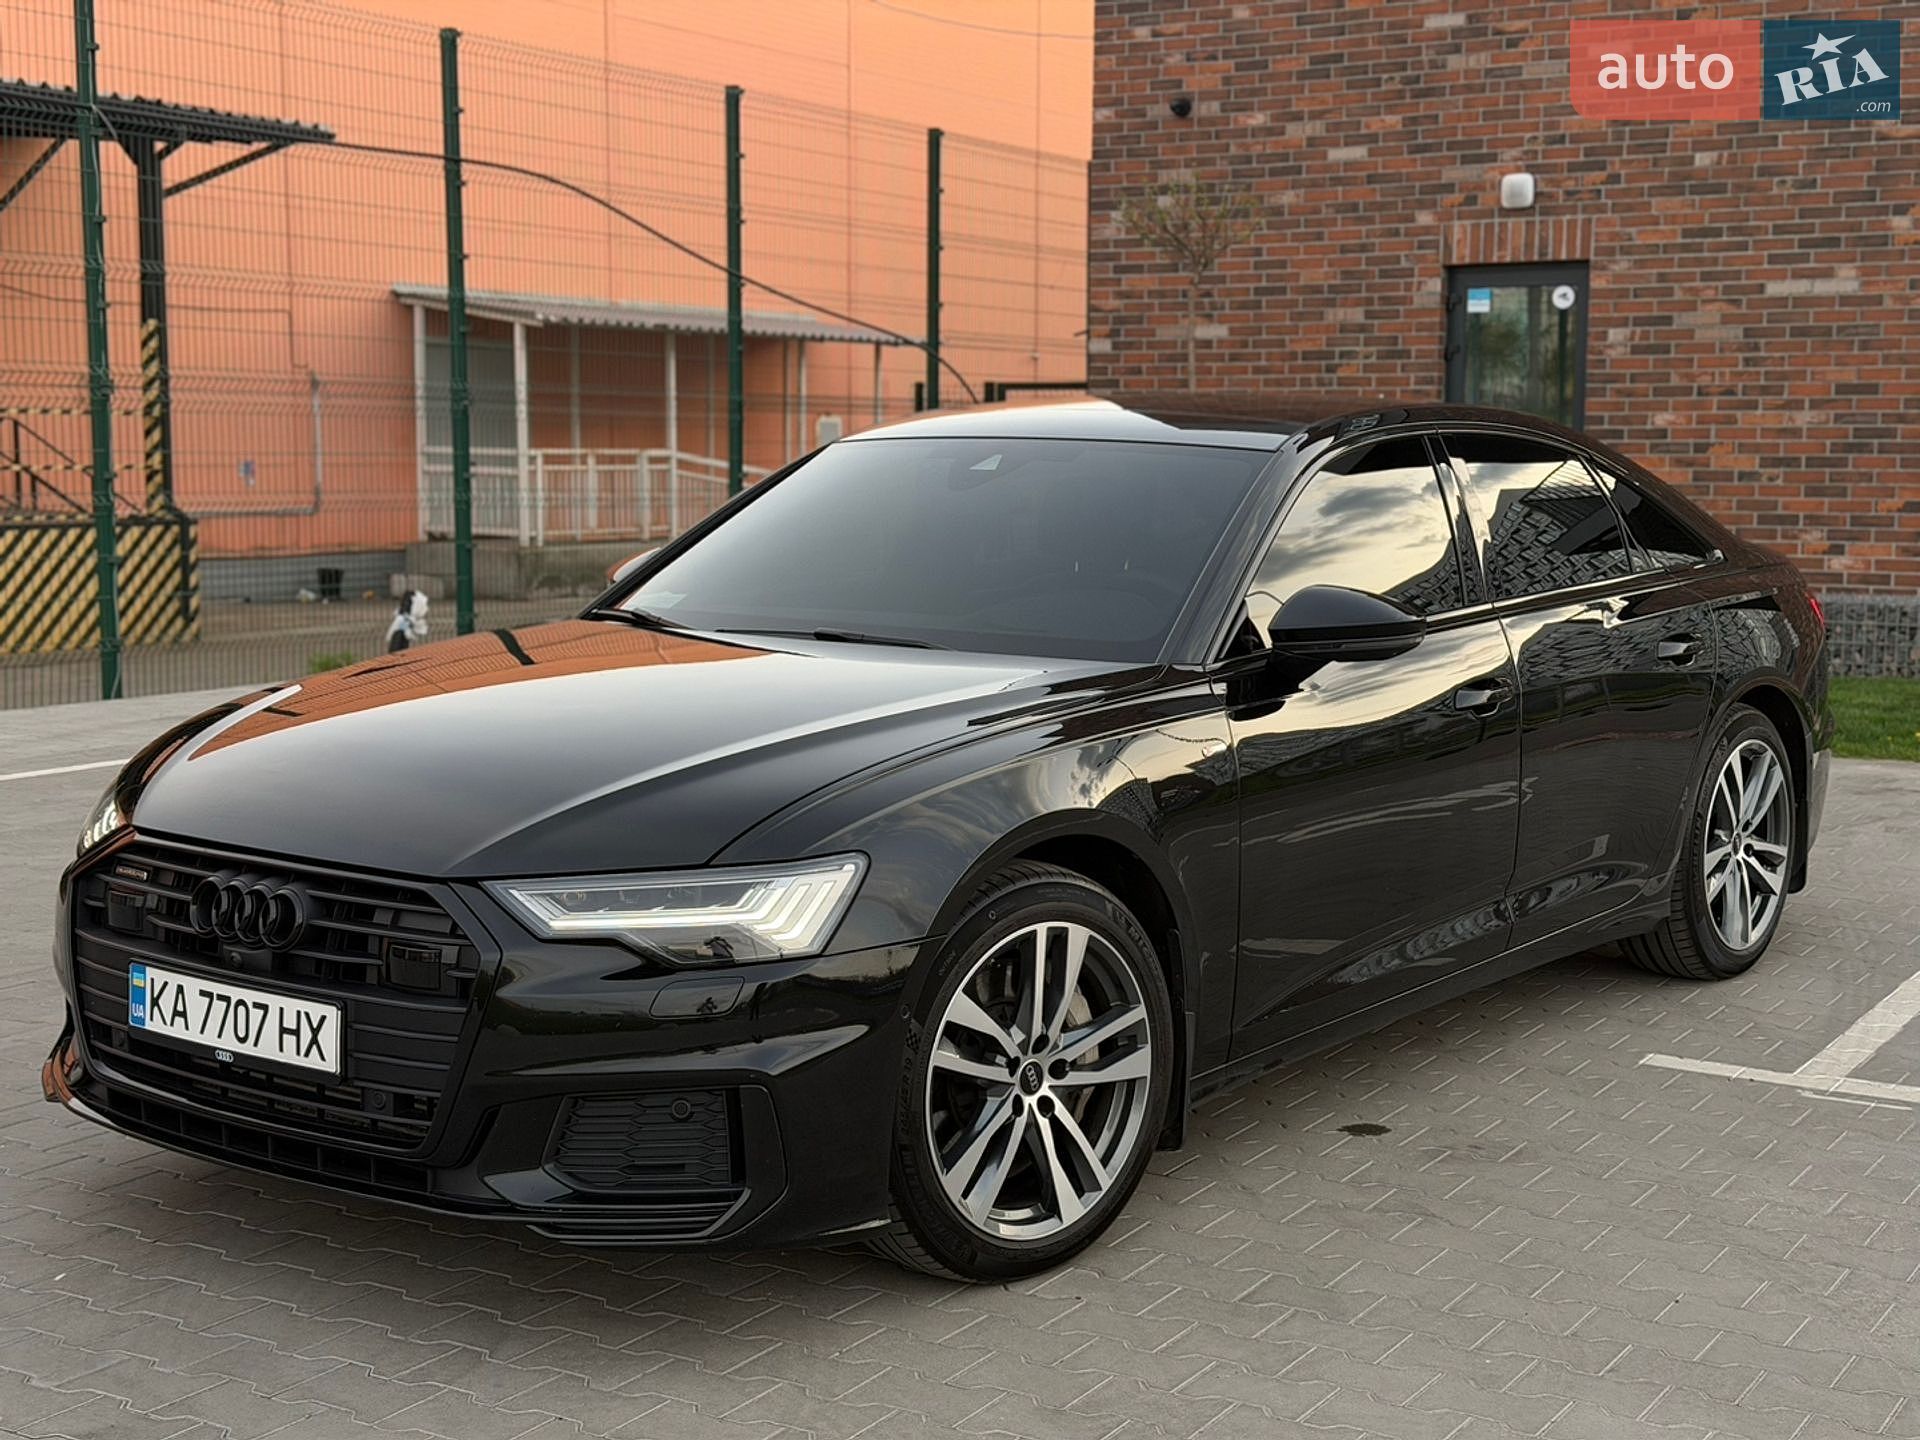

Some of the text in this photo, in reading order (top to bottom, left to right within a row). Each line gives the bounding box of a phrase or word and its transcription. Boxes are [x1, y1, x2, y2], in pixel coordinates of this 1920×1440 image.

[131, 1002, 145, 1018] UA
[149, 977, 328, 1063] KA 7707 HX
